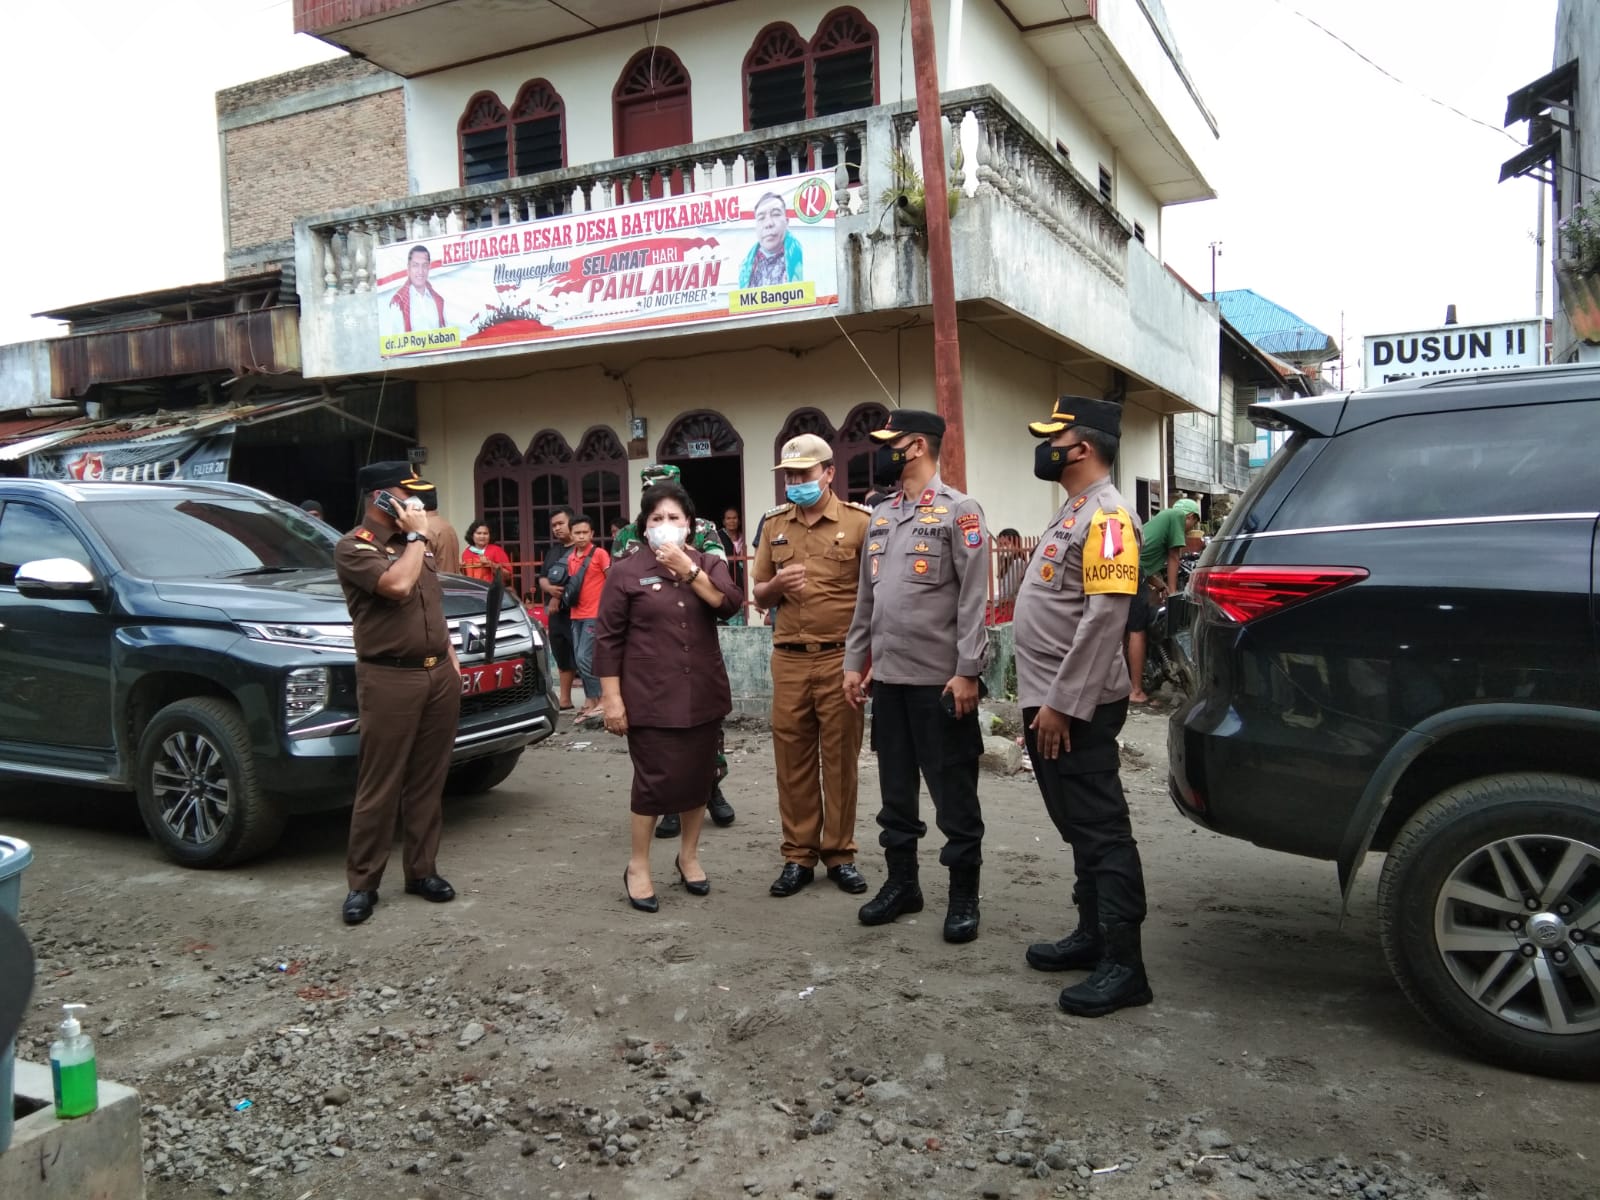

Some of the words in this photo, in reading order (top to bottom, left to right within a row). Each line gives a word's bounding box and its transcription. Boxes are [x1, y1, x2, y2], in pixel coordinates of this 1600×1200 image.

[442, 232, 521, 265] KELUARGA
[523, 223, 573, 253] BESAR
[576, 216, 618, 244] DESA
[621, 195, 740, 236] BATUKARANG
[493, 256, 570, 287] Mengucapkan
[582, 249, 649, 276] SELAMAT
[652, 247, 678, 264] HARI
[588, 259, 722, 304] PAHLAWAN
[643, 296, 653, 309] 10
[655, 288, 708, 307] NOVEMBER
[740, 292, 759, 306] MK
[760, 288, 804, 305] Bangun
[410, 334, 427, 349] Roy
[428, 331, 456, 345] Kaban
[1373, 332, 1491, 367] DUSUN
[1506, 328, 1525, 356] II
[911, 527, 941, 537] POLRI
[1052, 530, 1073, 541] POLRI
[460, 670, 484, 694] BK
[495, 667, 504, 689] 1
